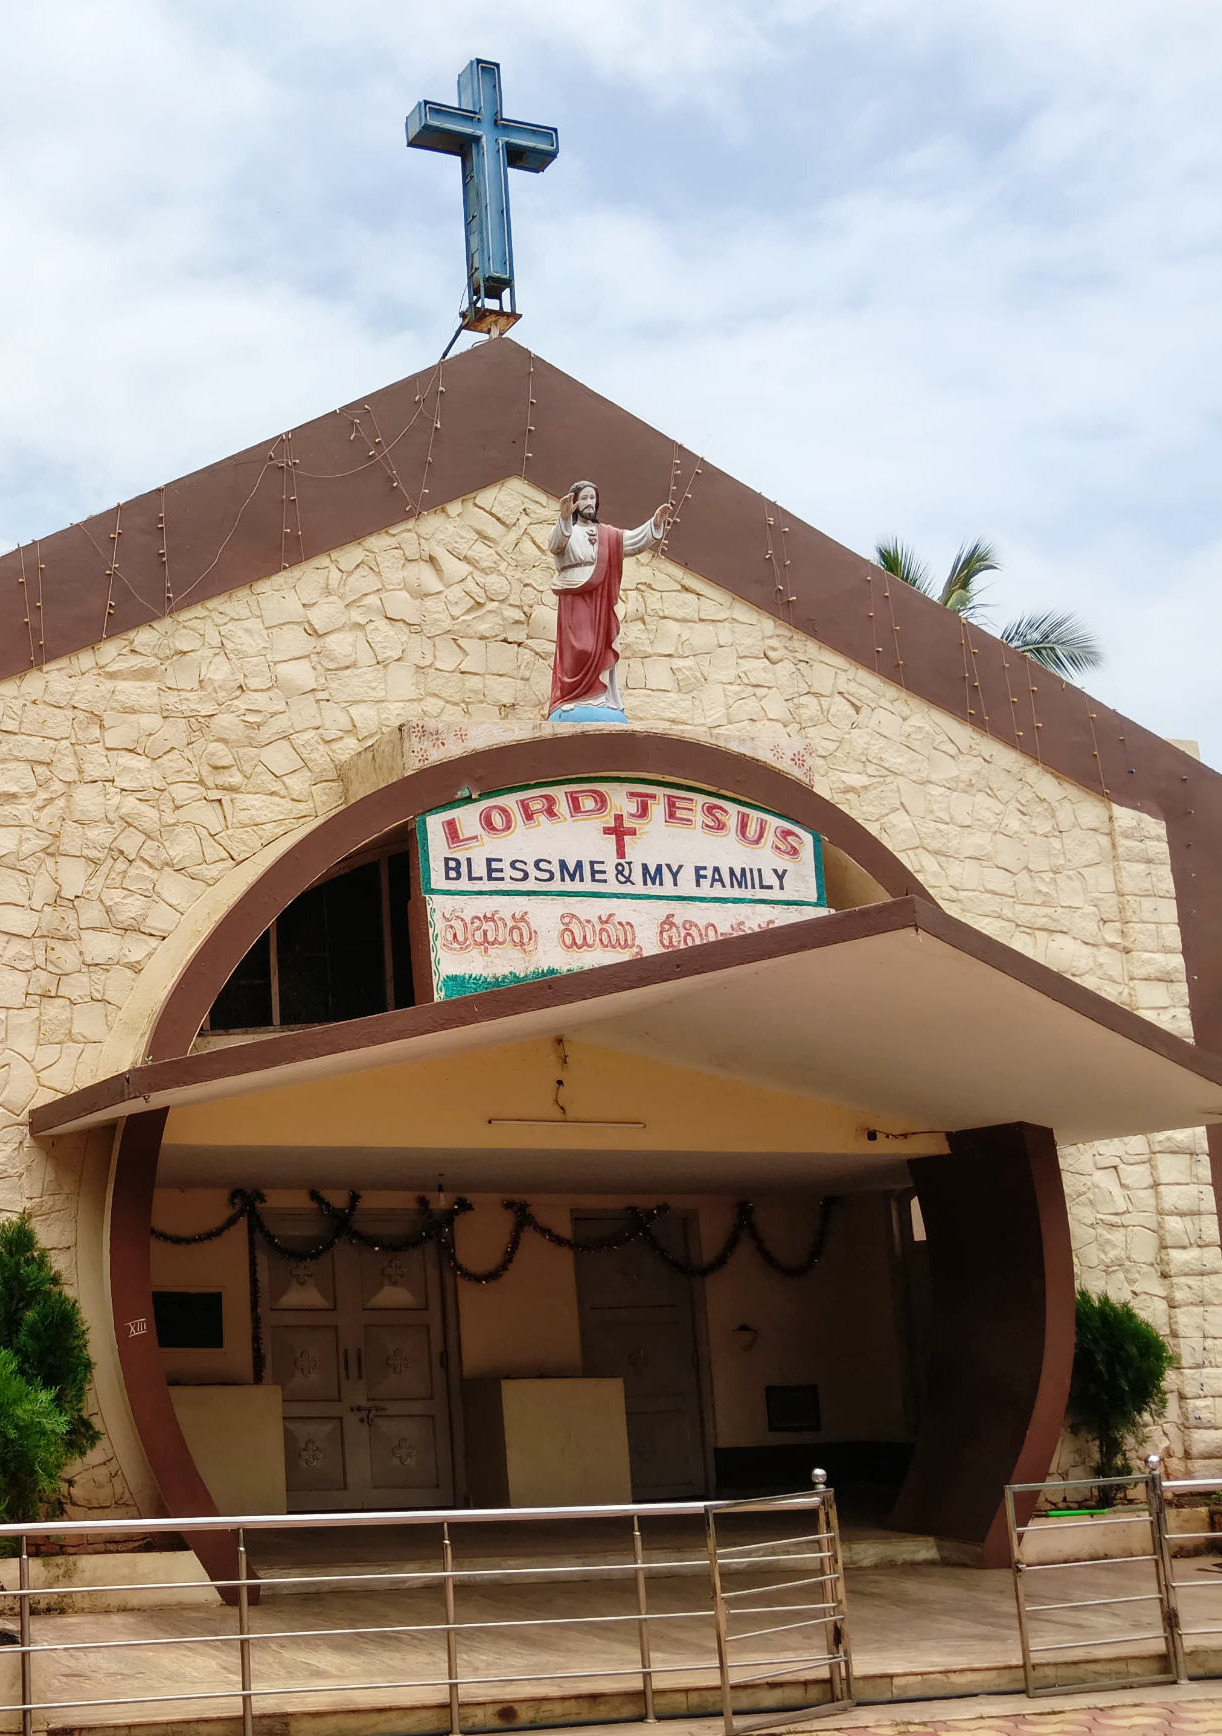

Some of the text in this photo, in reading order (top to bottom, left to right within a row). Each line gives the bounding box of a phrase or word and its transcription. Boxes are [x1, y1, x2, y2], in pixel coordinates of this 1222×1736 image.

[442, 788, 805, 863] LORD JESUS
[614, 861, 636, 886] &
[641, 862, 684, 887] MY
[694, 865, 788, 891] FAMILY
